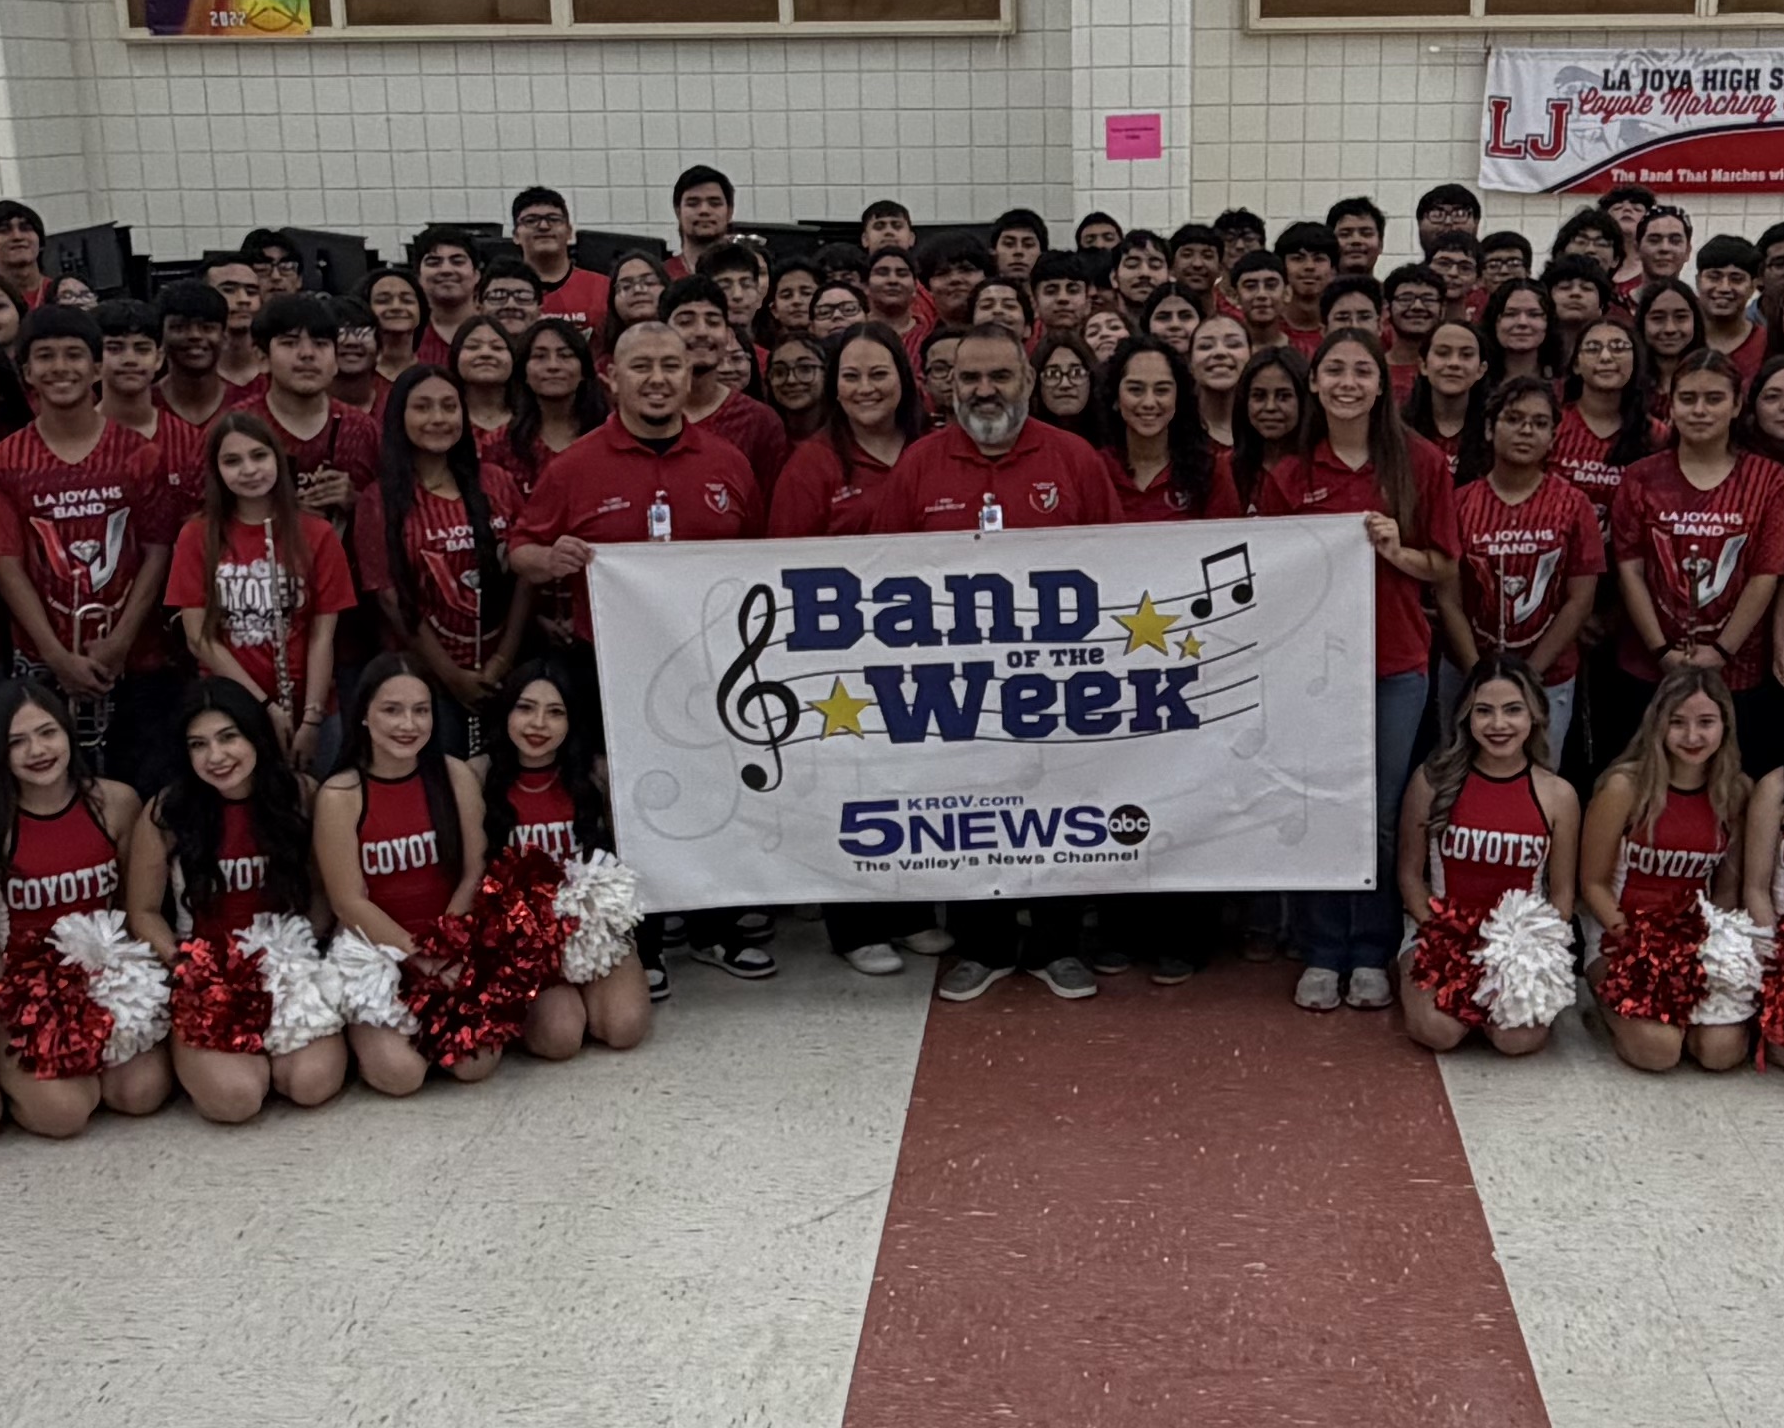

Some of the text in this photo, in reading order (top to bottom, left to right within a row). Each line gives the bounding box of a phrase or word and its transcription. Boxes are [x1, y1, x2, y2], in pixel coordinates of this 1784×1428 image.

[1602, 68, 1631, 91] LA
[1639, 68, 1692, 91] JOYA
[1702, 68, 1761, 91] HIGH
[1578, 87, 1654, 124] Coyote
[1661, 86, 1776, 123] Marching
[1485, 96, 1573, 161] LJ
[1611, 169, 1635, 182] The
[1640, 169, 1672, 182] Band
[1677, 168, 1707, 182] That
[1711, 168, 1765, 182] Marches
[1573, 469, 1621, 486] BAND
[33, 486, 122, 507] LA JOYA HS
[53, 502, 106, 519] BAND
[1659, 510, 1743, 525] LA JOYA HS
[426, 528, 448, 540] LA
[1472, 529, 1554, 544] LA JOYA HS
[1673, 523, 1725, 537] BAND
[1488, 543, 1538, 556] BAND
[1006, 649, 1040, 668] OF
[907, 795, 1024, 811] KRGV.com
[1109, 813, 1150, 833] abc
[361, 830, 439, 875] COYOT
[1441, 824, 1545, 868] COYOTES
[853, 848, 1138, 872] The Valley's News Channel
[7, 857, 119, 910] COYOTES
